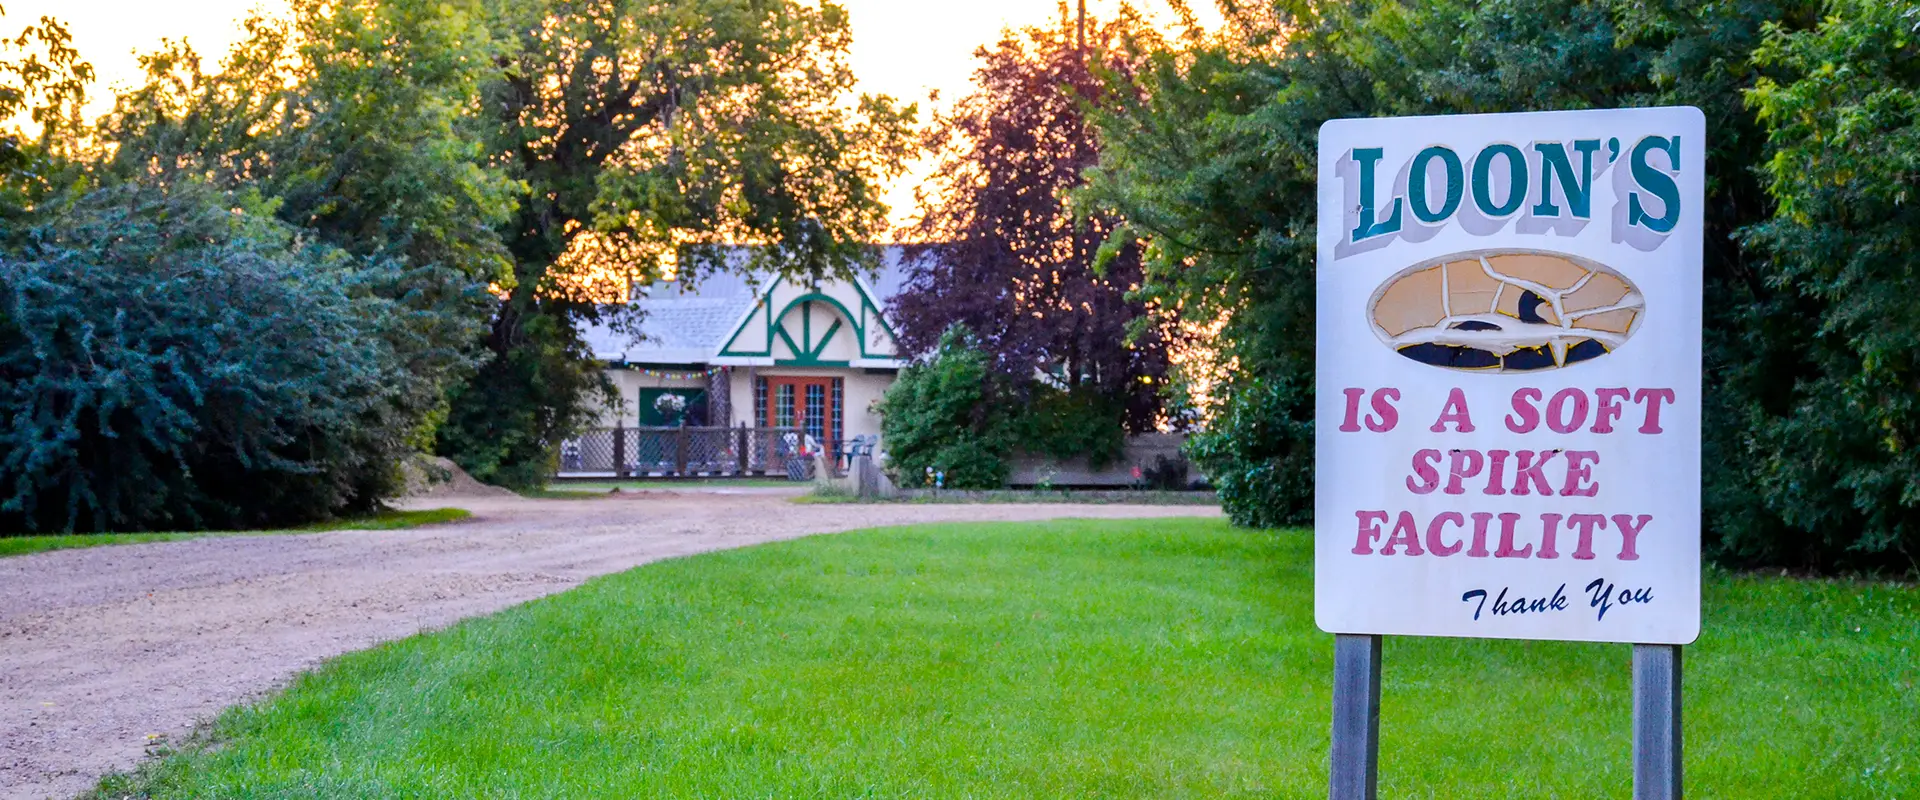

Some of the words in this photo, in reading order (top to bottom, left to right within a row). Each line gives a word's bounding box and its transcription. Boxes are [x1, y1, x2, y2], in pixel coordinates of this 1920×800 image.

[1351, 134, 1682, 243] LOON'S
[1338, 387, 1401, 433] IS
[1429, 387, 1476, 433] A
[1504, 387, 1676, 435] SOFT
[1405, 448, 1600, 498] SPIKE
[1351, 510, 1653, 561] FACILITY
[1461, 582, 1570, 621] Thank
[1584, 577, 1654, 622] You
